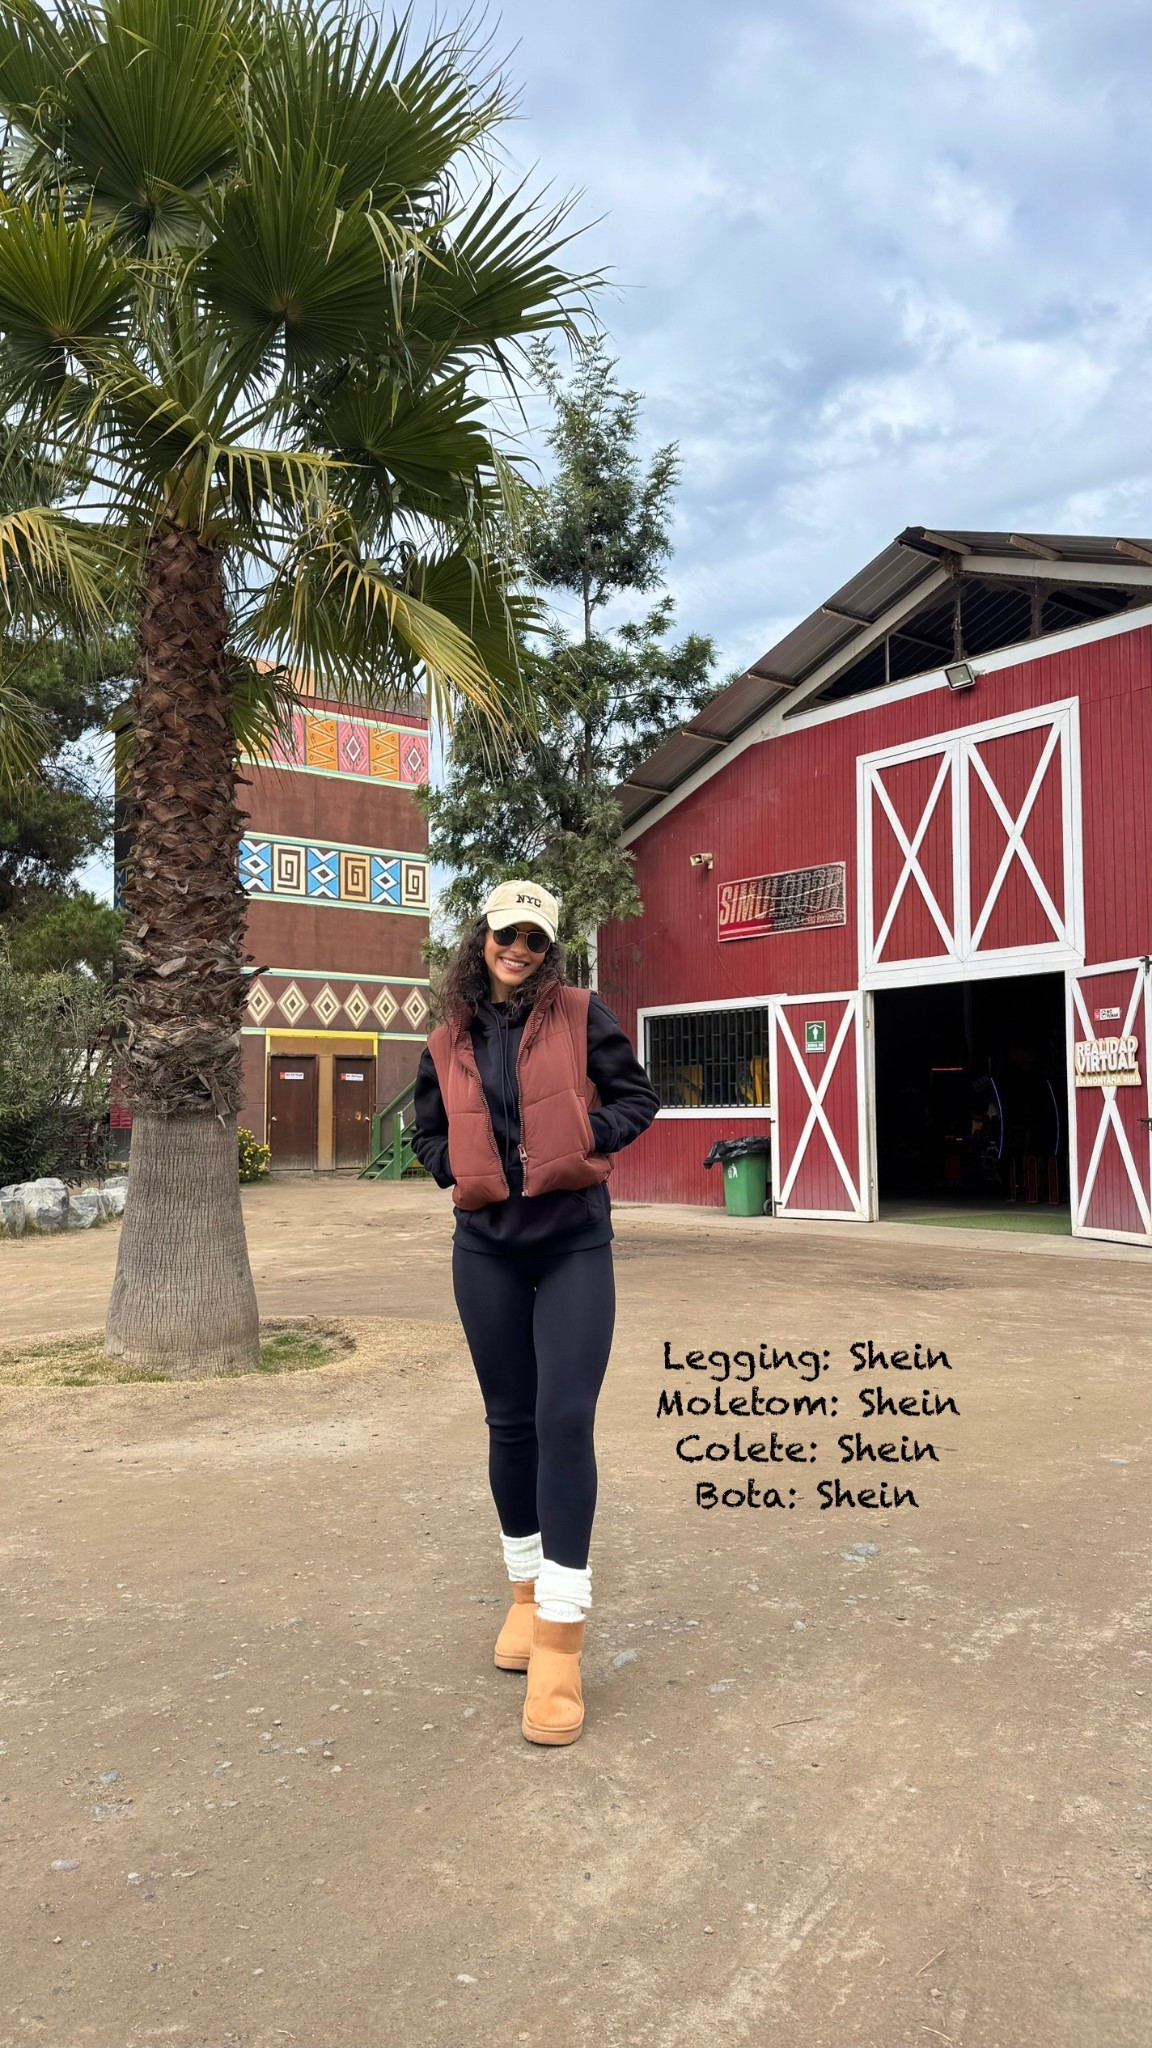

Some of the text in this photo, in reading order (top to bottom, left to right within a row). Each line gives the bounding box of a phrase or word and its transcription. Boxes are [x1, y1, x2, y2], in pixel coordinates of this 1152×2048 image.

[516, 894, 542, 908] NYC
[1076, 1037, 1137, 1057] REALIDAD
[1076, 1052, 1137, 1073] VIRTUAL
[1077, 1076, 1086, 1086] EN
